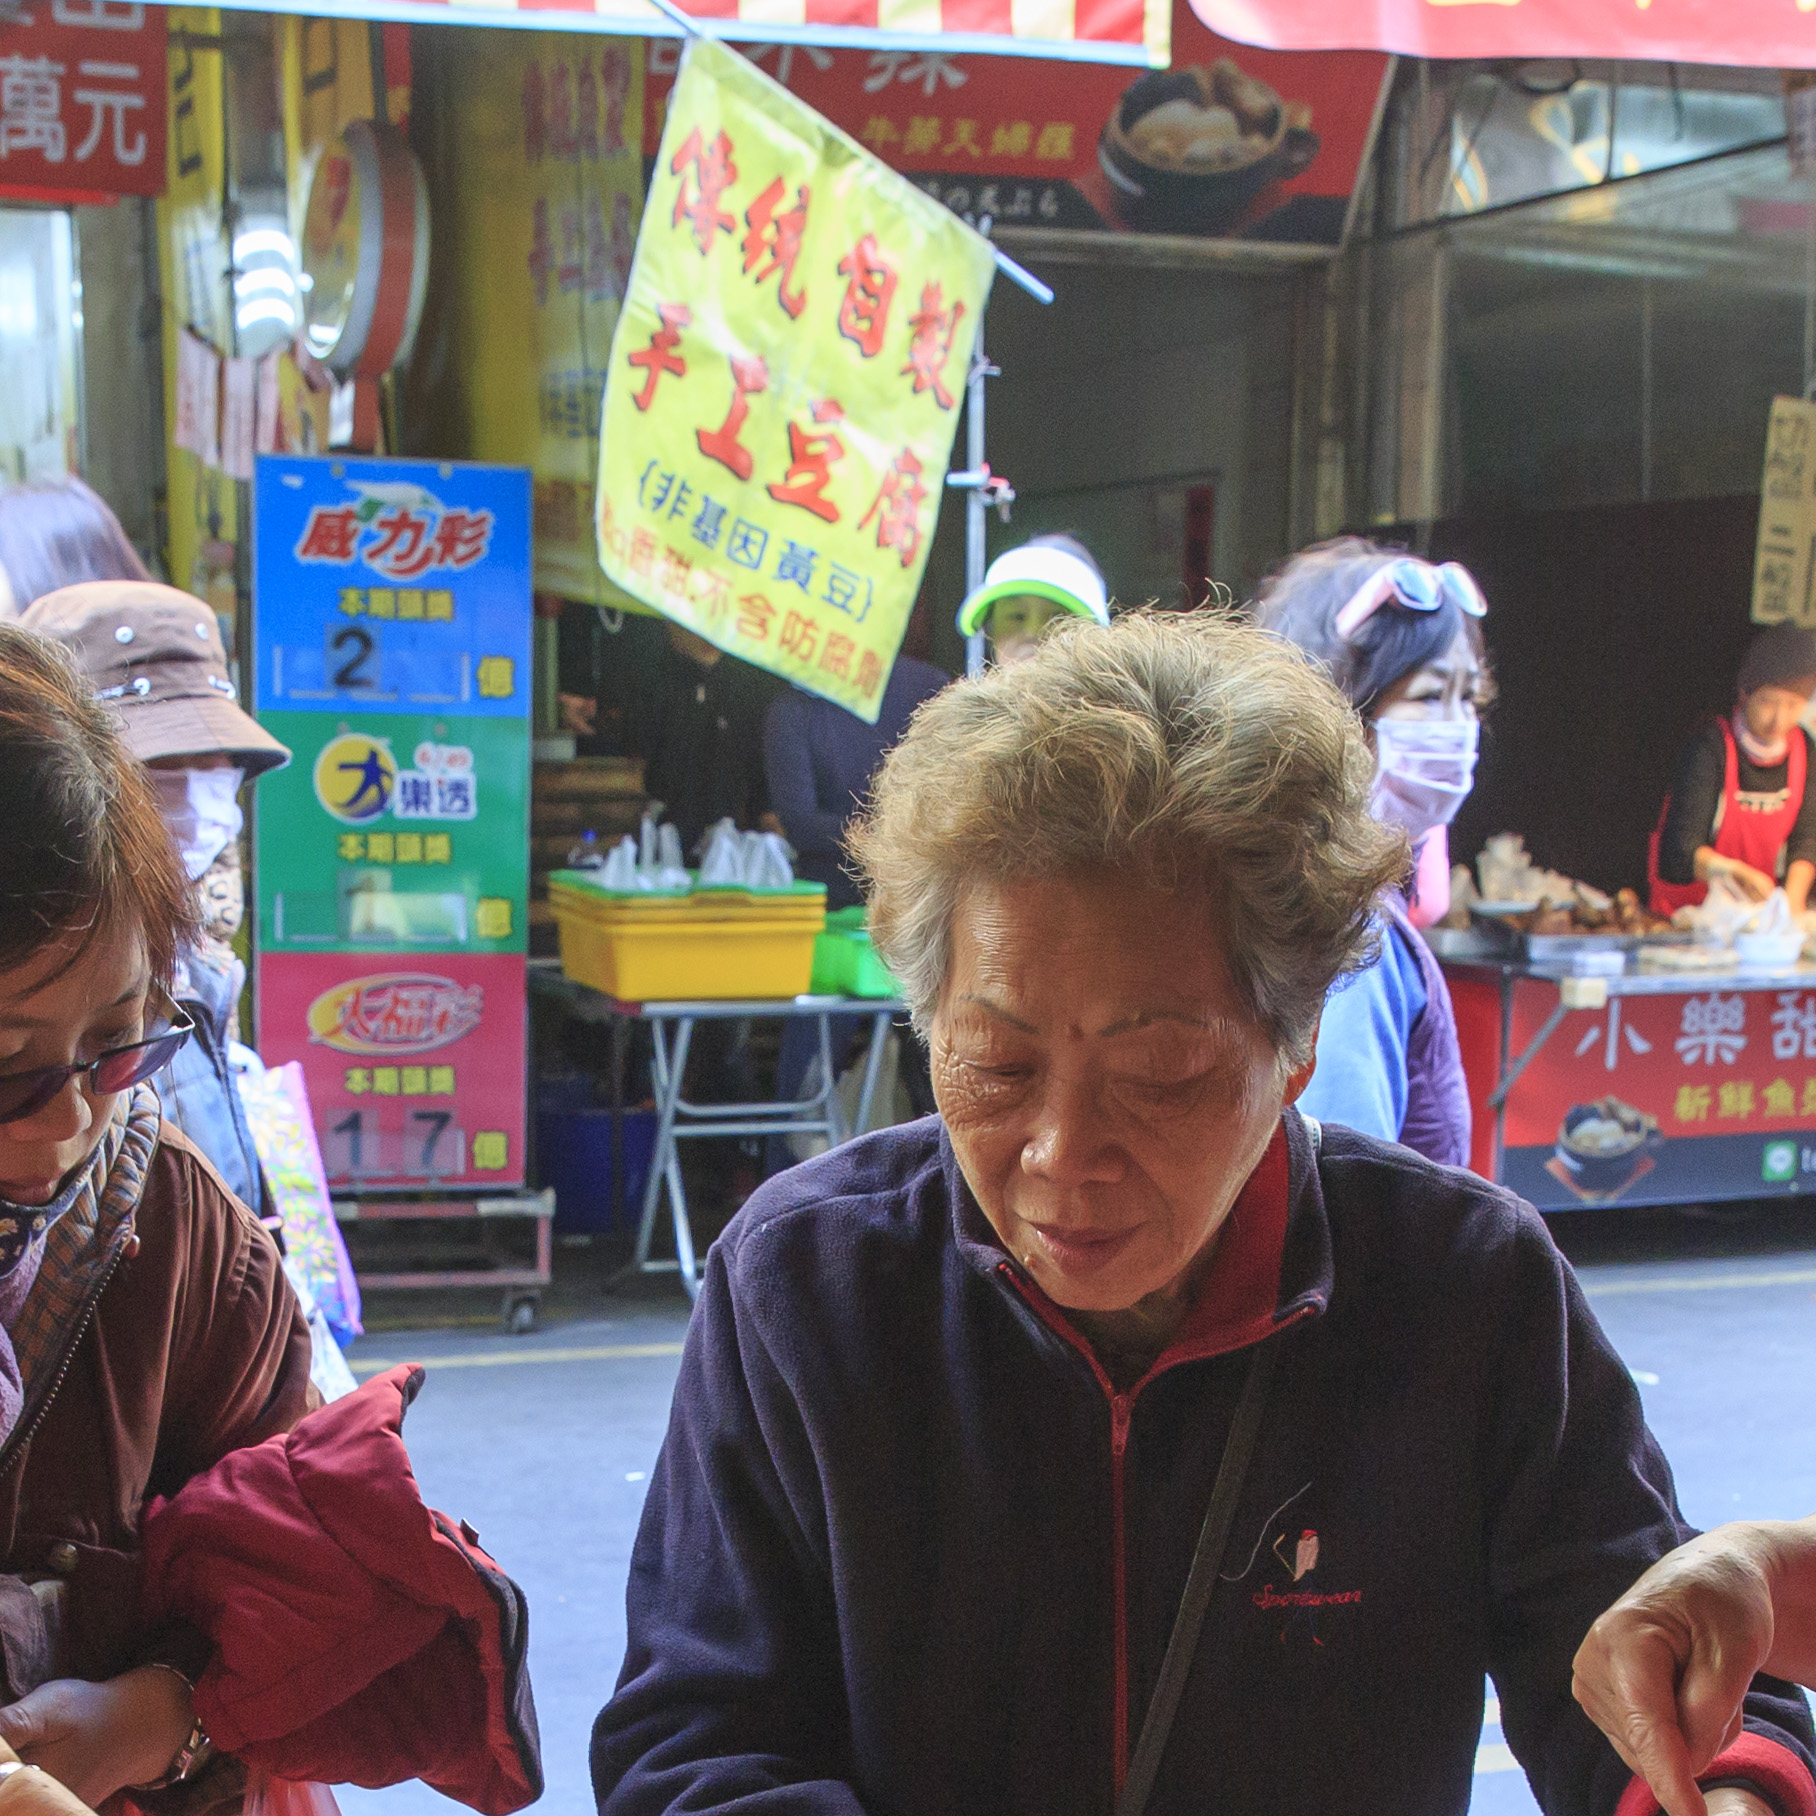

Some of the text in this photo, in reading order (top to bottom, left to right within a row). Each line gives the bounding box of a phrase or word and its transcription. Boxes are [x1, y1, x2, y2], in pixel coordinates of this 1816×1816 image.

[670, 124, 967, 410] 傳統自製
[627, 303, 931, 568] 手工豆腐
[296, 507, 495, 580] 威力彩
[333, 625, 374, 688] 2
